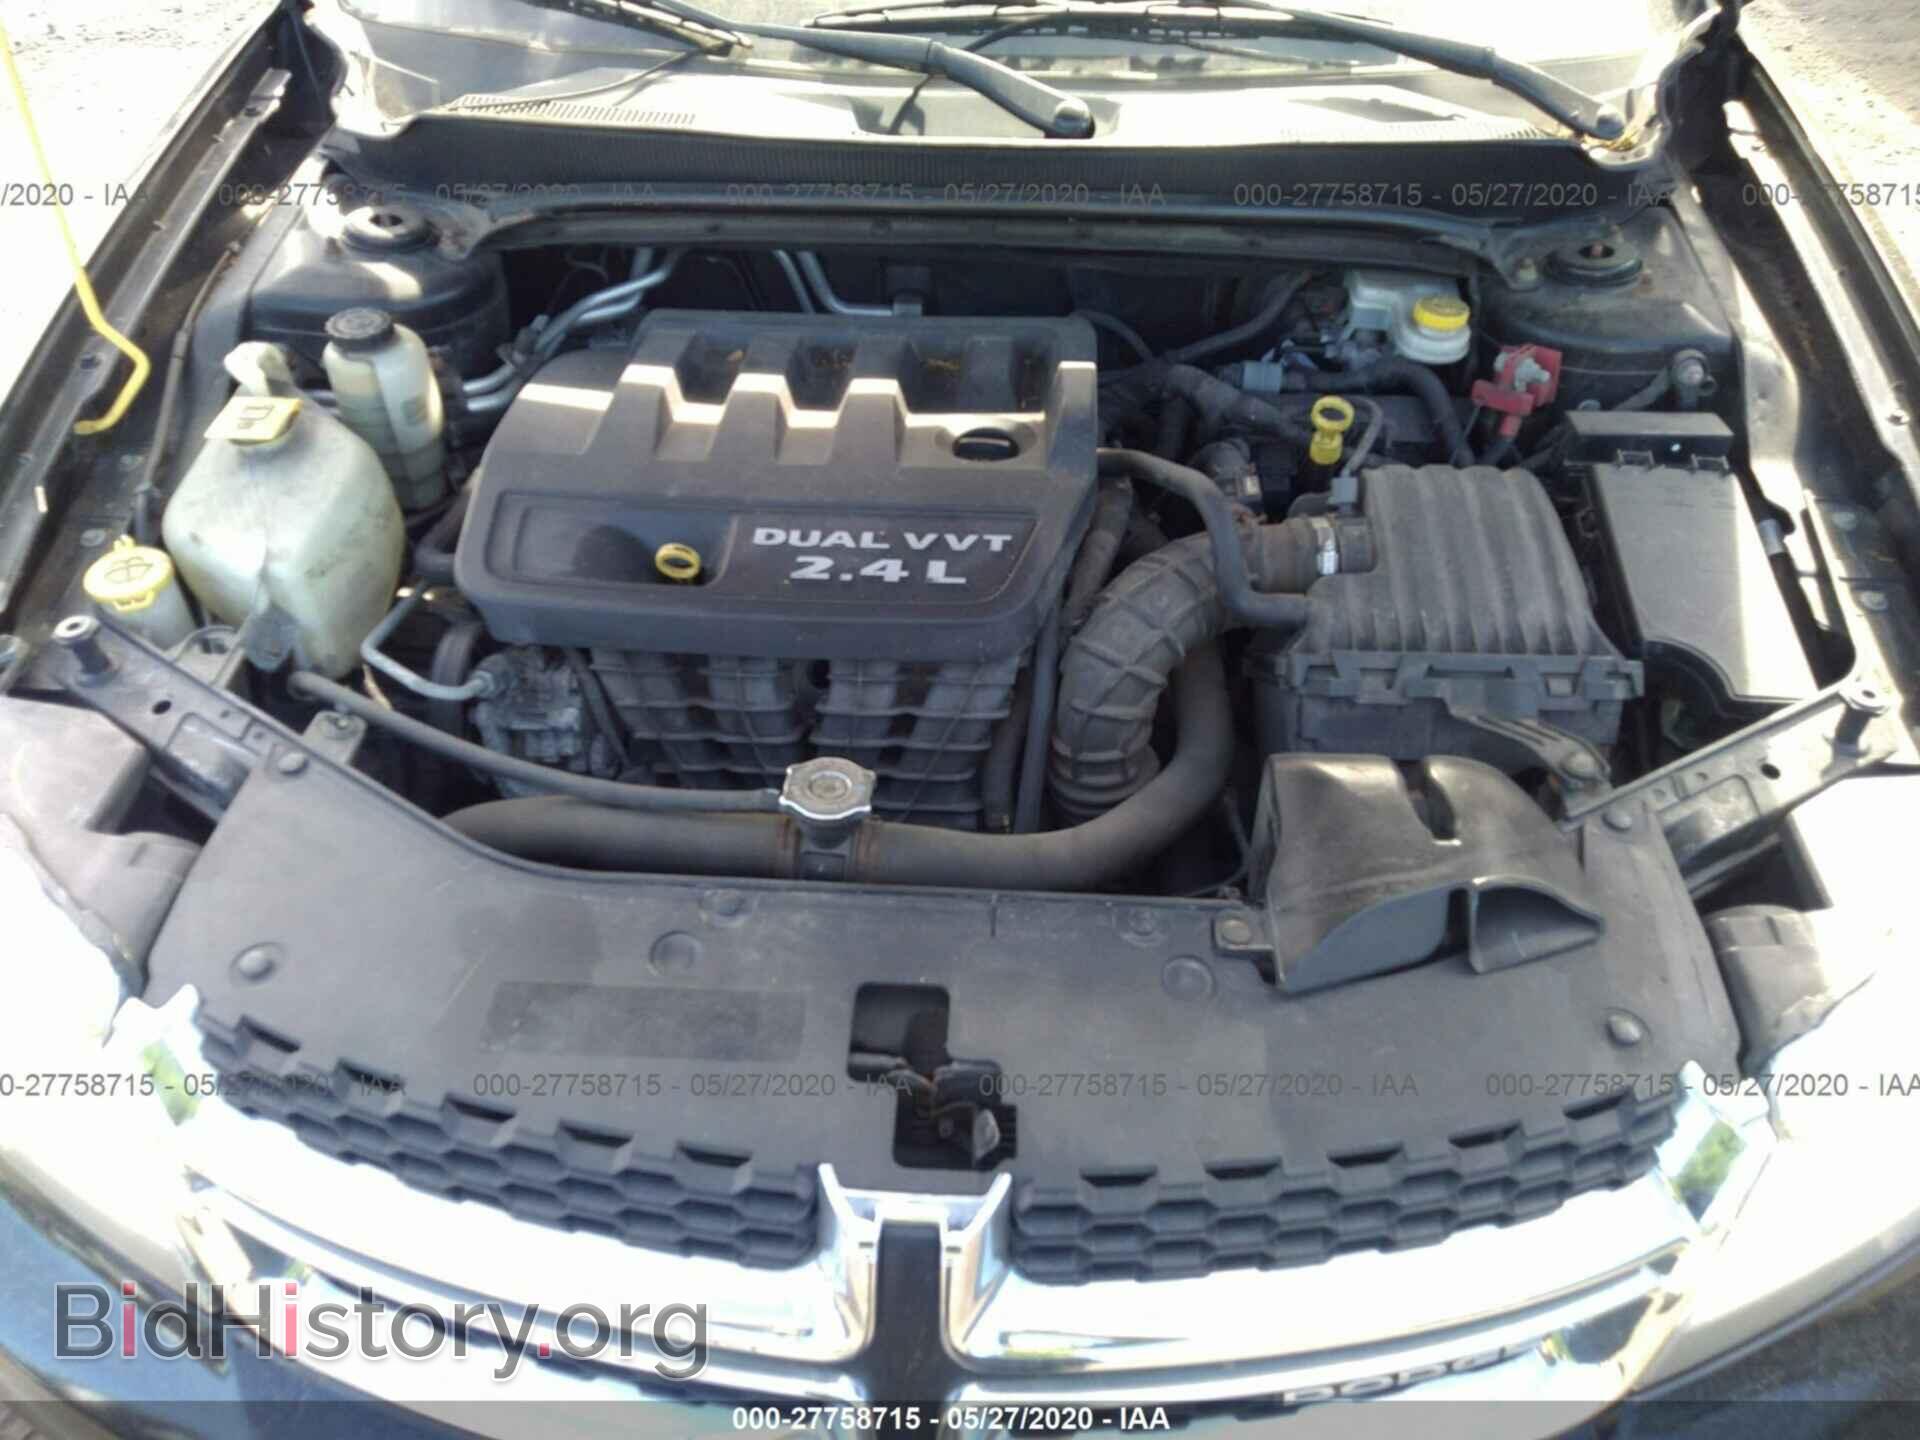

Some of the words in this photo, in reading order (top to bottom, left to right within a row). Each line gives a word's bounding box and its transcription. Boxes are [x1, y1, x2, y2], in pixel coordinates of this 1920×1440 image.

[752, 527, 890, 549] DUAL
[903, 532, 1012, 551] VVT
[790, 556, 909, 582] 2.4
